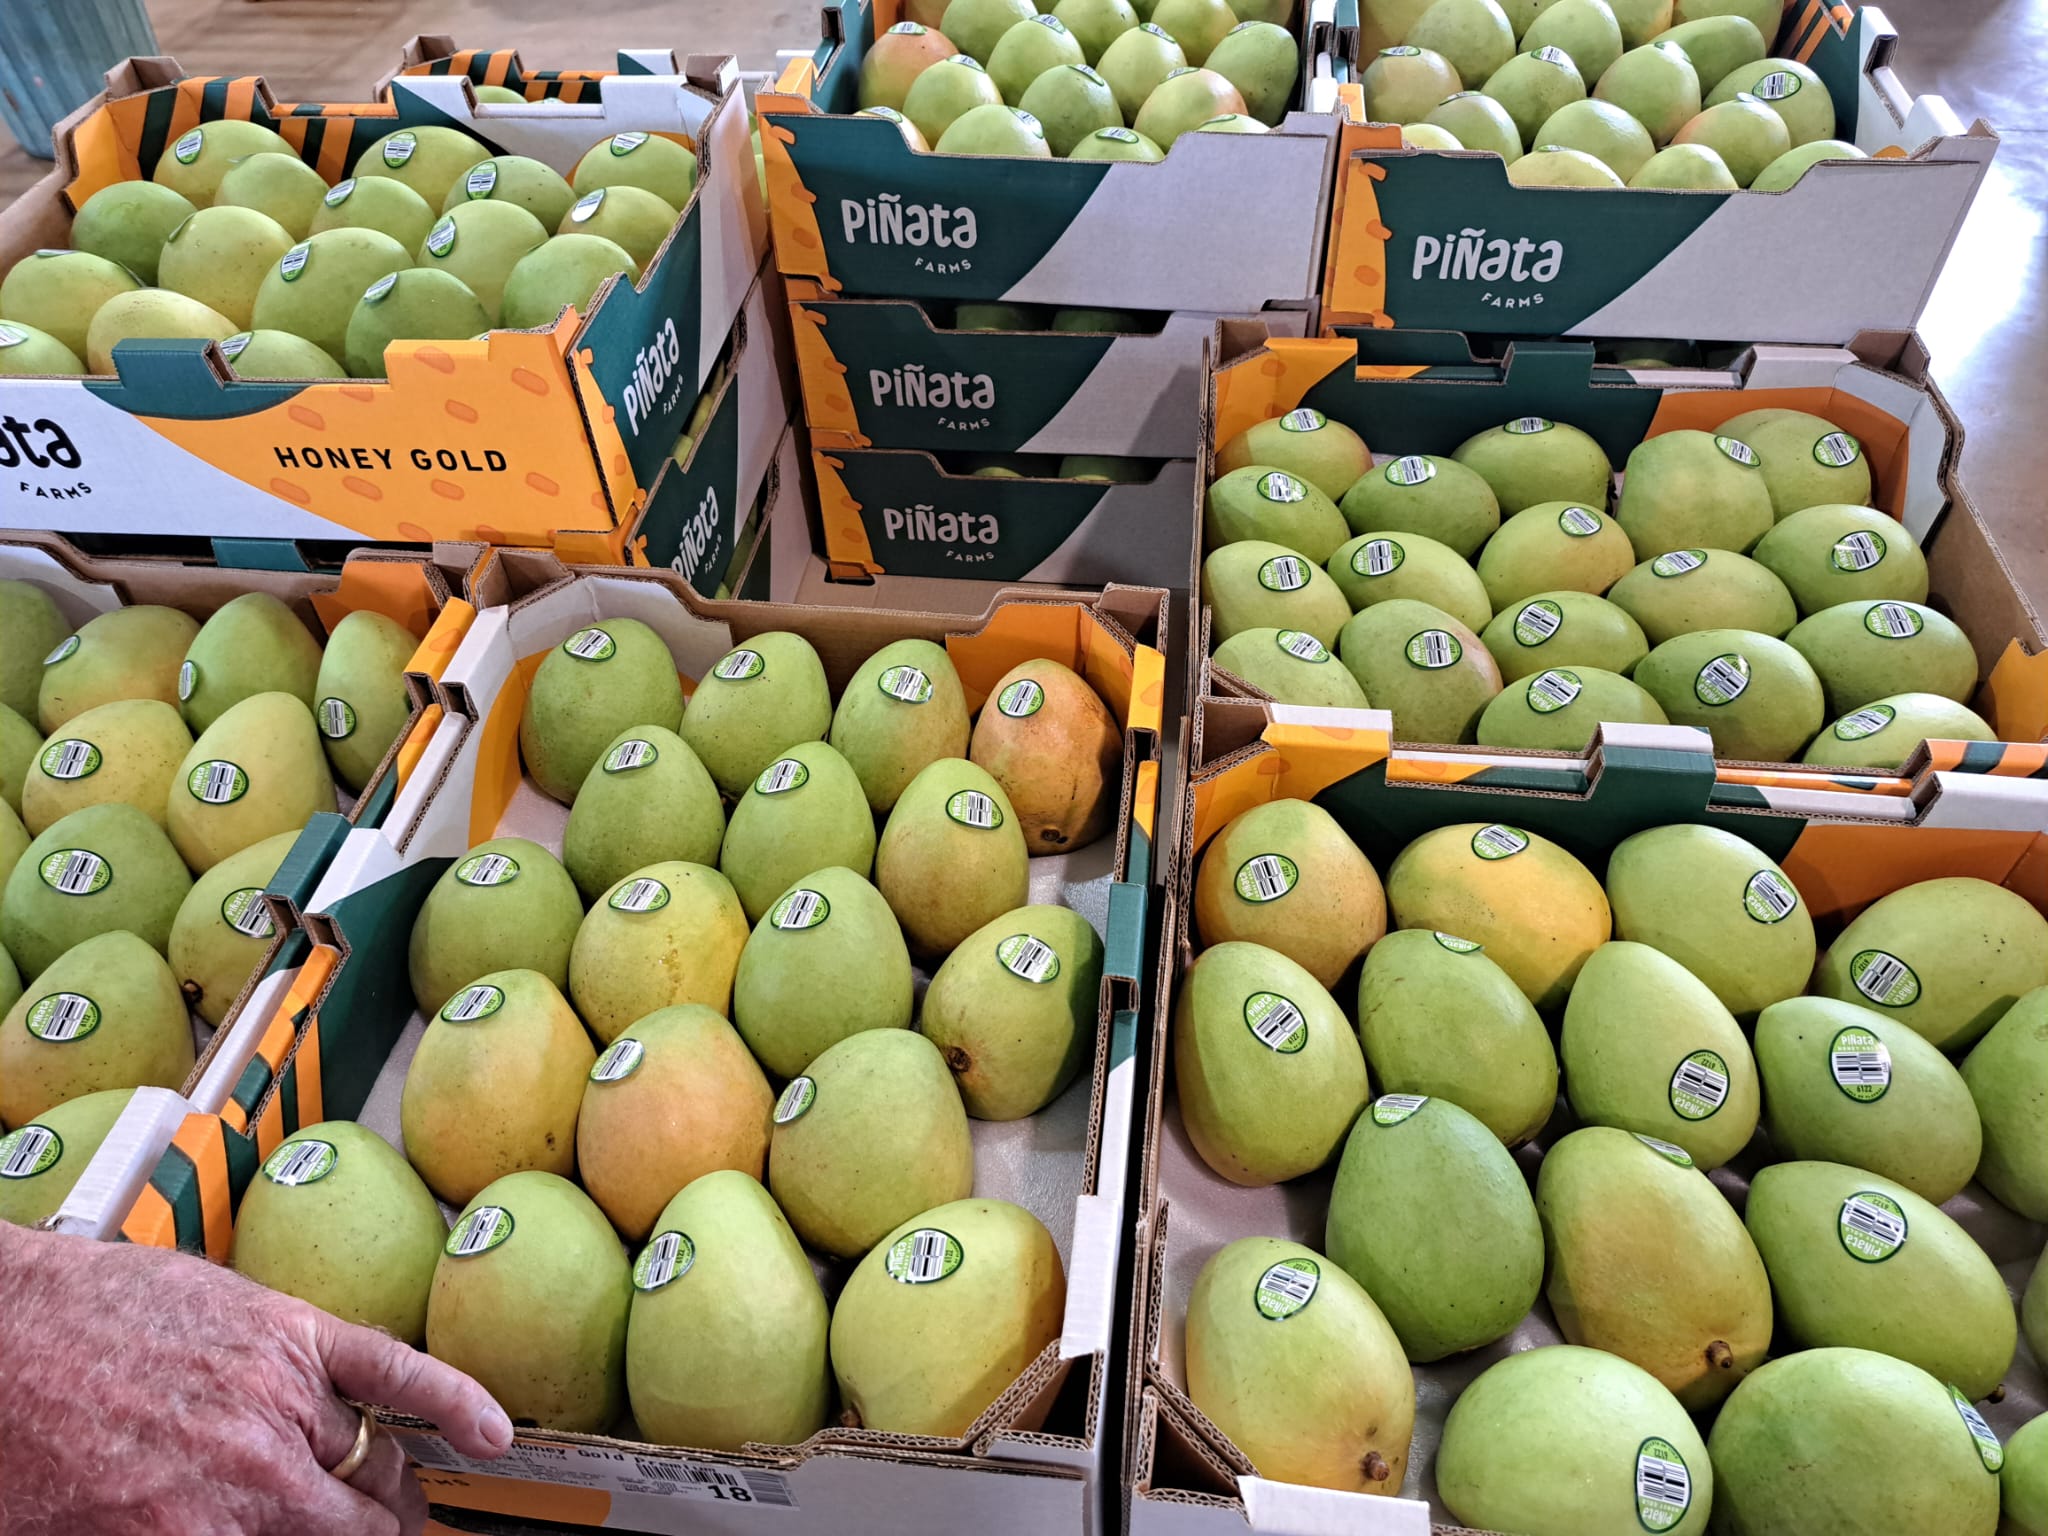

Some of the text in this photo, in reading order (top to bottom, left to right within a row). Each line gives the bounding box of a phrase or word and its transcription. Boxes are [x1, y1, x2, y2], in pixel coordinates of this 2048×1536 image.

[915, 257, 972, 274] FARMS
[1481, 293, 1544, 309] FARMS
[663, 374, 683, 415] FARMS
[937, 417, 991, 431] FARMS
[273, 446, 507, 472] HONEY GOLD
[20, 481, 92, 500] FARMS
[946, 550, 995, 562] FARMS
[80, 1014, 91, 1027] 6122
[1287, 1032, 1300, 1045] 6122
[1701, 1059, 1716, 1070] 6122
[1856, 1085, 1872, 1093] 6122
[1872, 1200, 1889, 1210] 6122
[511, 1441, 566, 1455] Honey
[578, 1449, 625, 1461] Gold
[708, 1485, 752, 1502] 18
